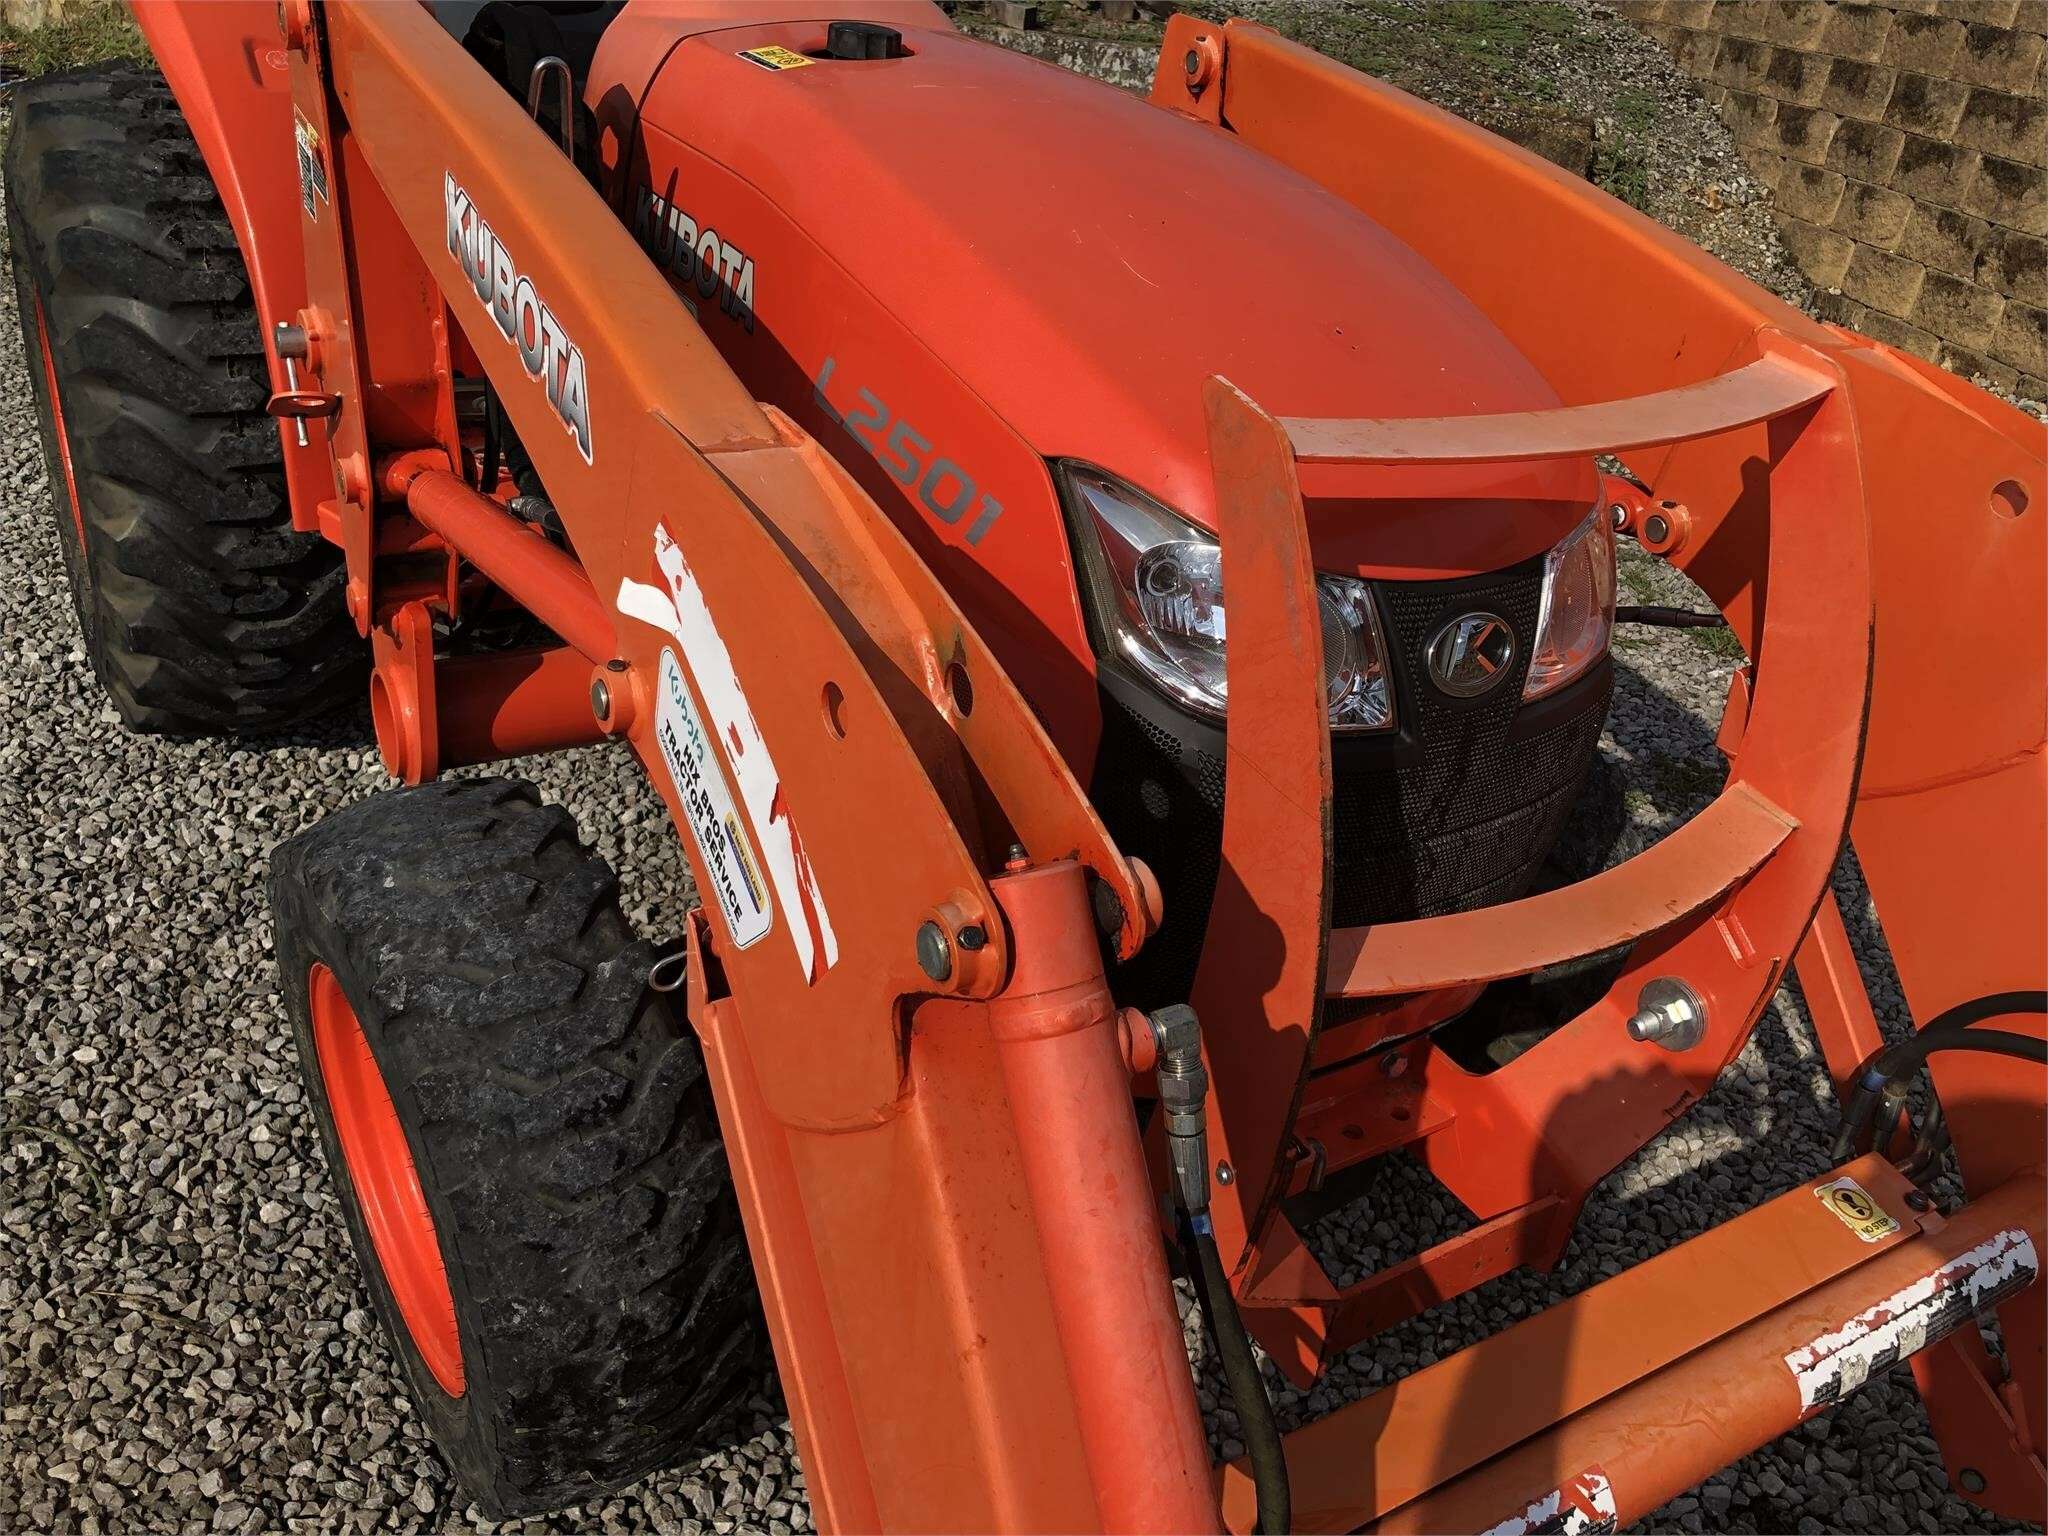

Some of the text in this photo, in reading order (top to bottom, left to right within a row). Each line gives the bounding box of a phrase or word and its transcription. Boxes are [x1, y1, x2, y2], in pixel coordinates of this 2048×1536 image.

[445, 170, 593, 465] KUBOTA
[635, 185, 754, 333] KUBOTA
[814, 357, 1003, 548] L2501
[668, 665, 704, 765] Kubota
[665, 719, 703, 823] TRACTOR
[704, 825, 742, 923] SERVICE
[683, 744, 727, 860] HIX BROS.
[1861, 1217, 1889, 1234] NO STEP
